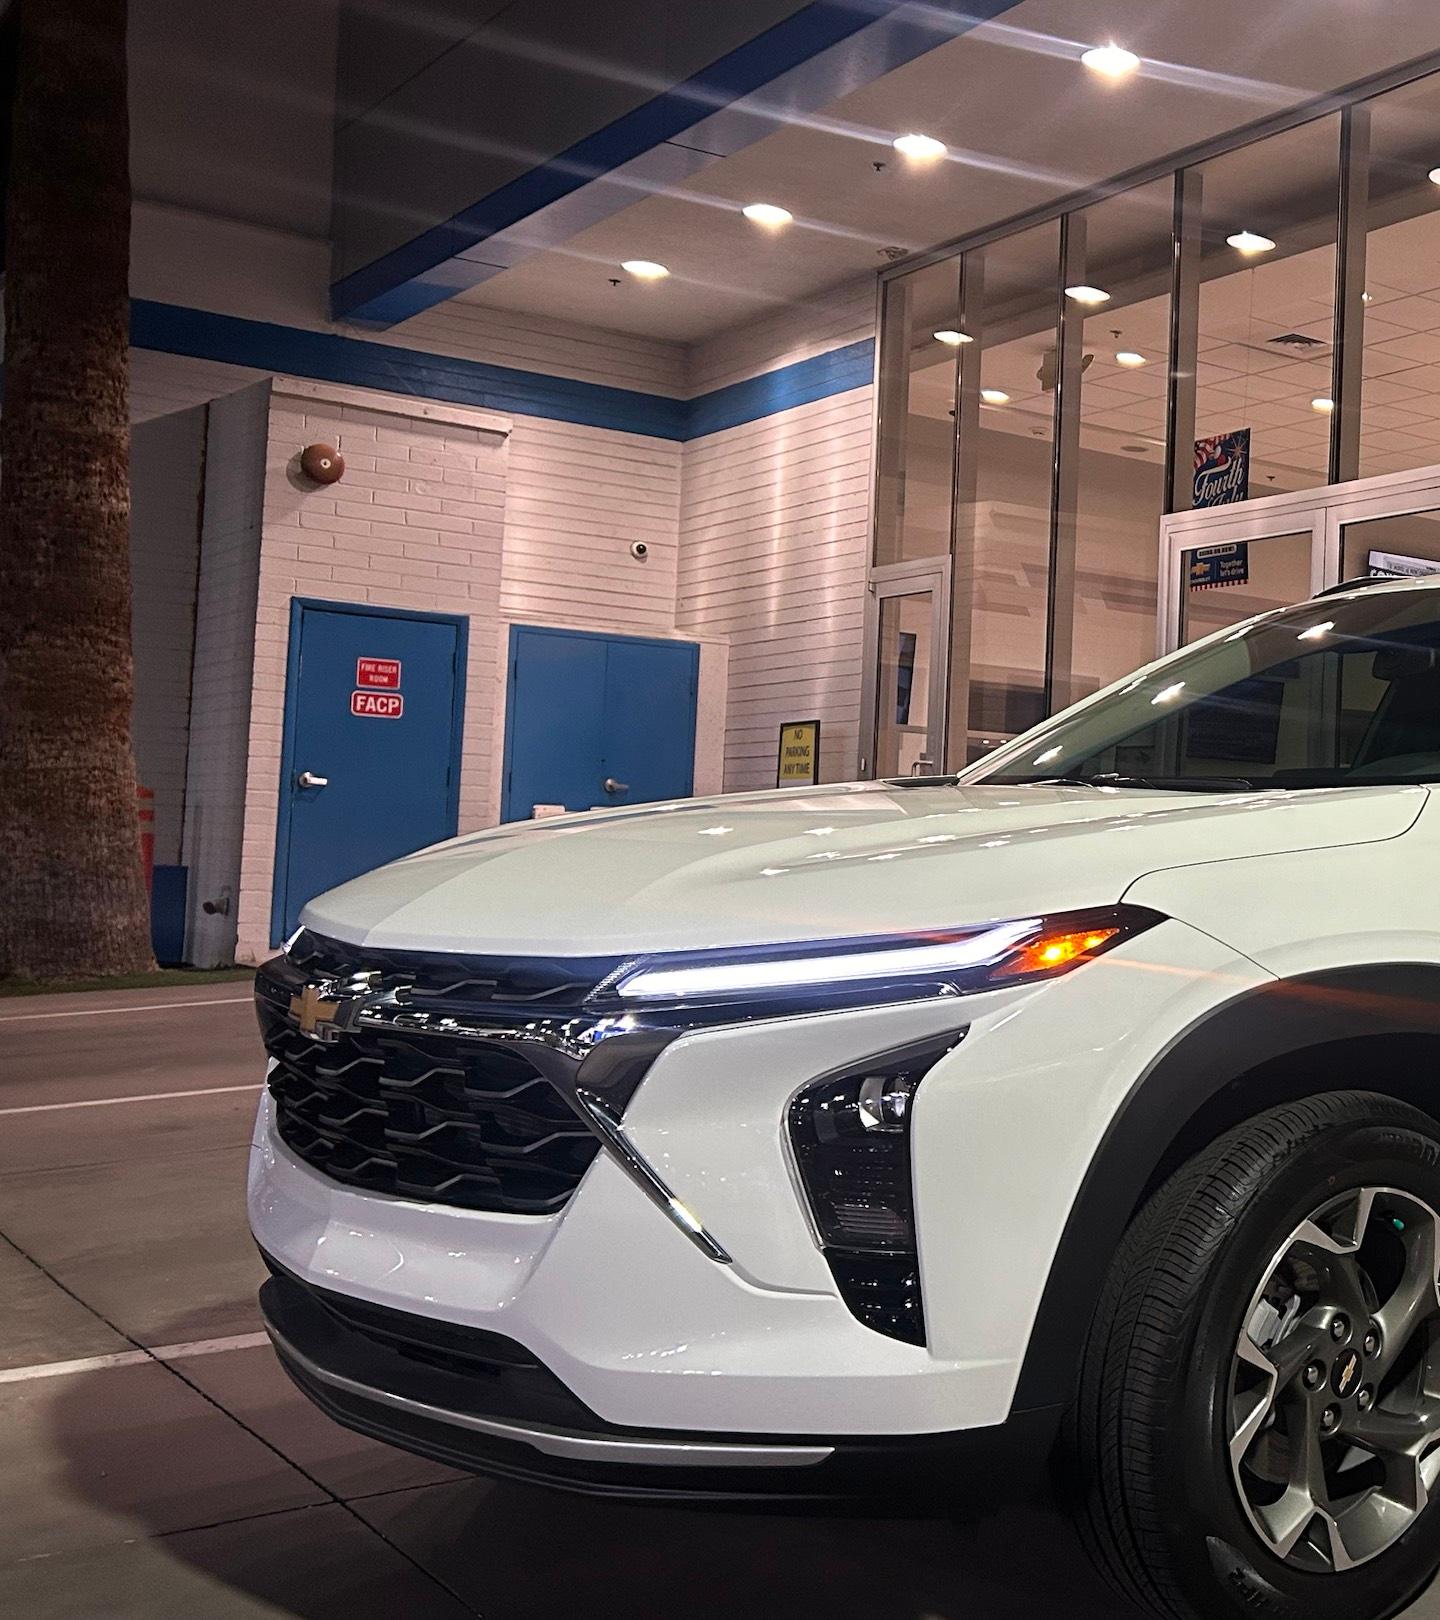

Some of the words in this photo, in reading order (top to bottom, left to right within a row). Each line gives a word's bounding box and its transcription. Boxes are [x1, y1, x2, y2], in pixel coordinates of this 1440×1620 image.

[1192, 456, 1245, 507] Fourth
[361, 662, 376, 673] FIRE
[369, 674, 389, 683] ROOM
[356, 695, 400, 714] FACP
[793, 728, 803, 740] NO
[785, 745, 810, 757] PARKING
